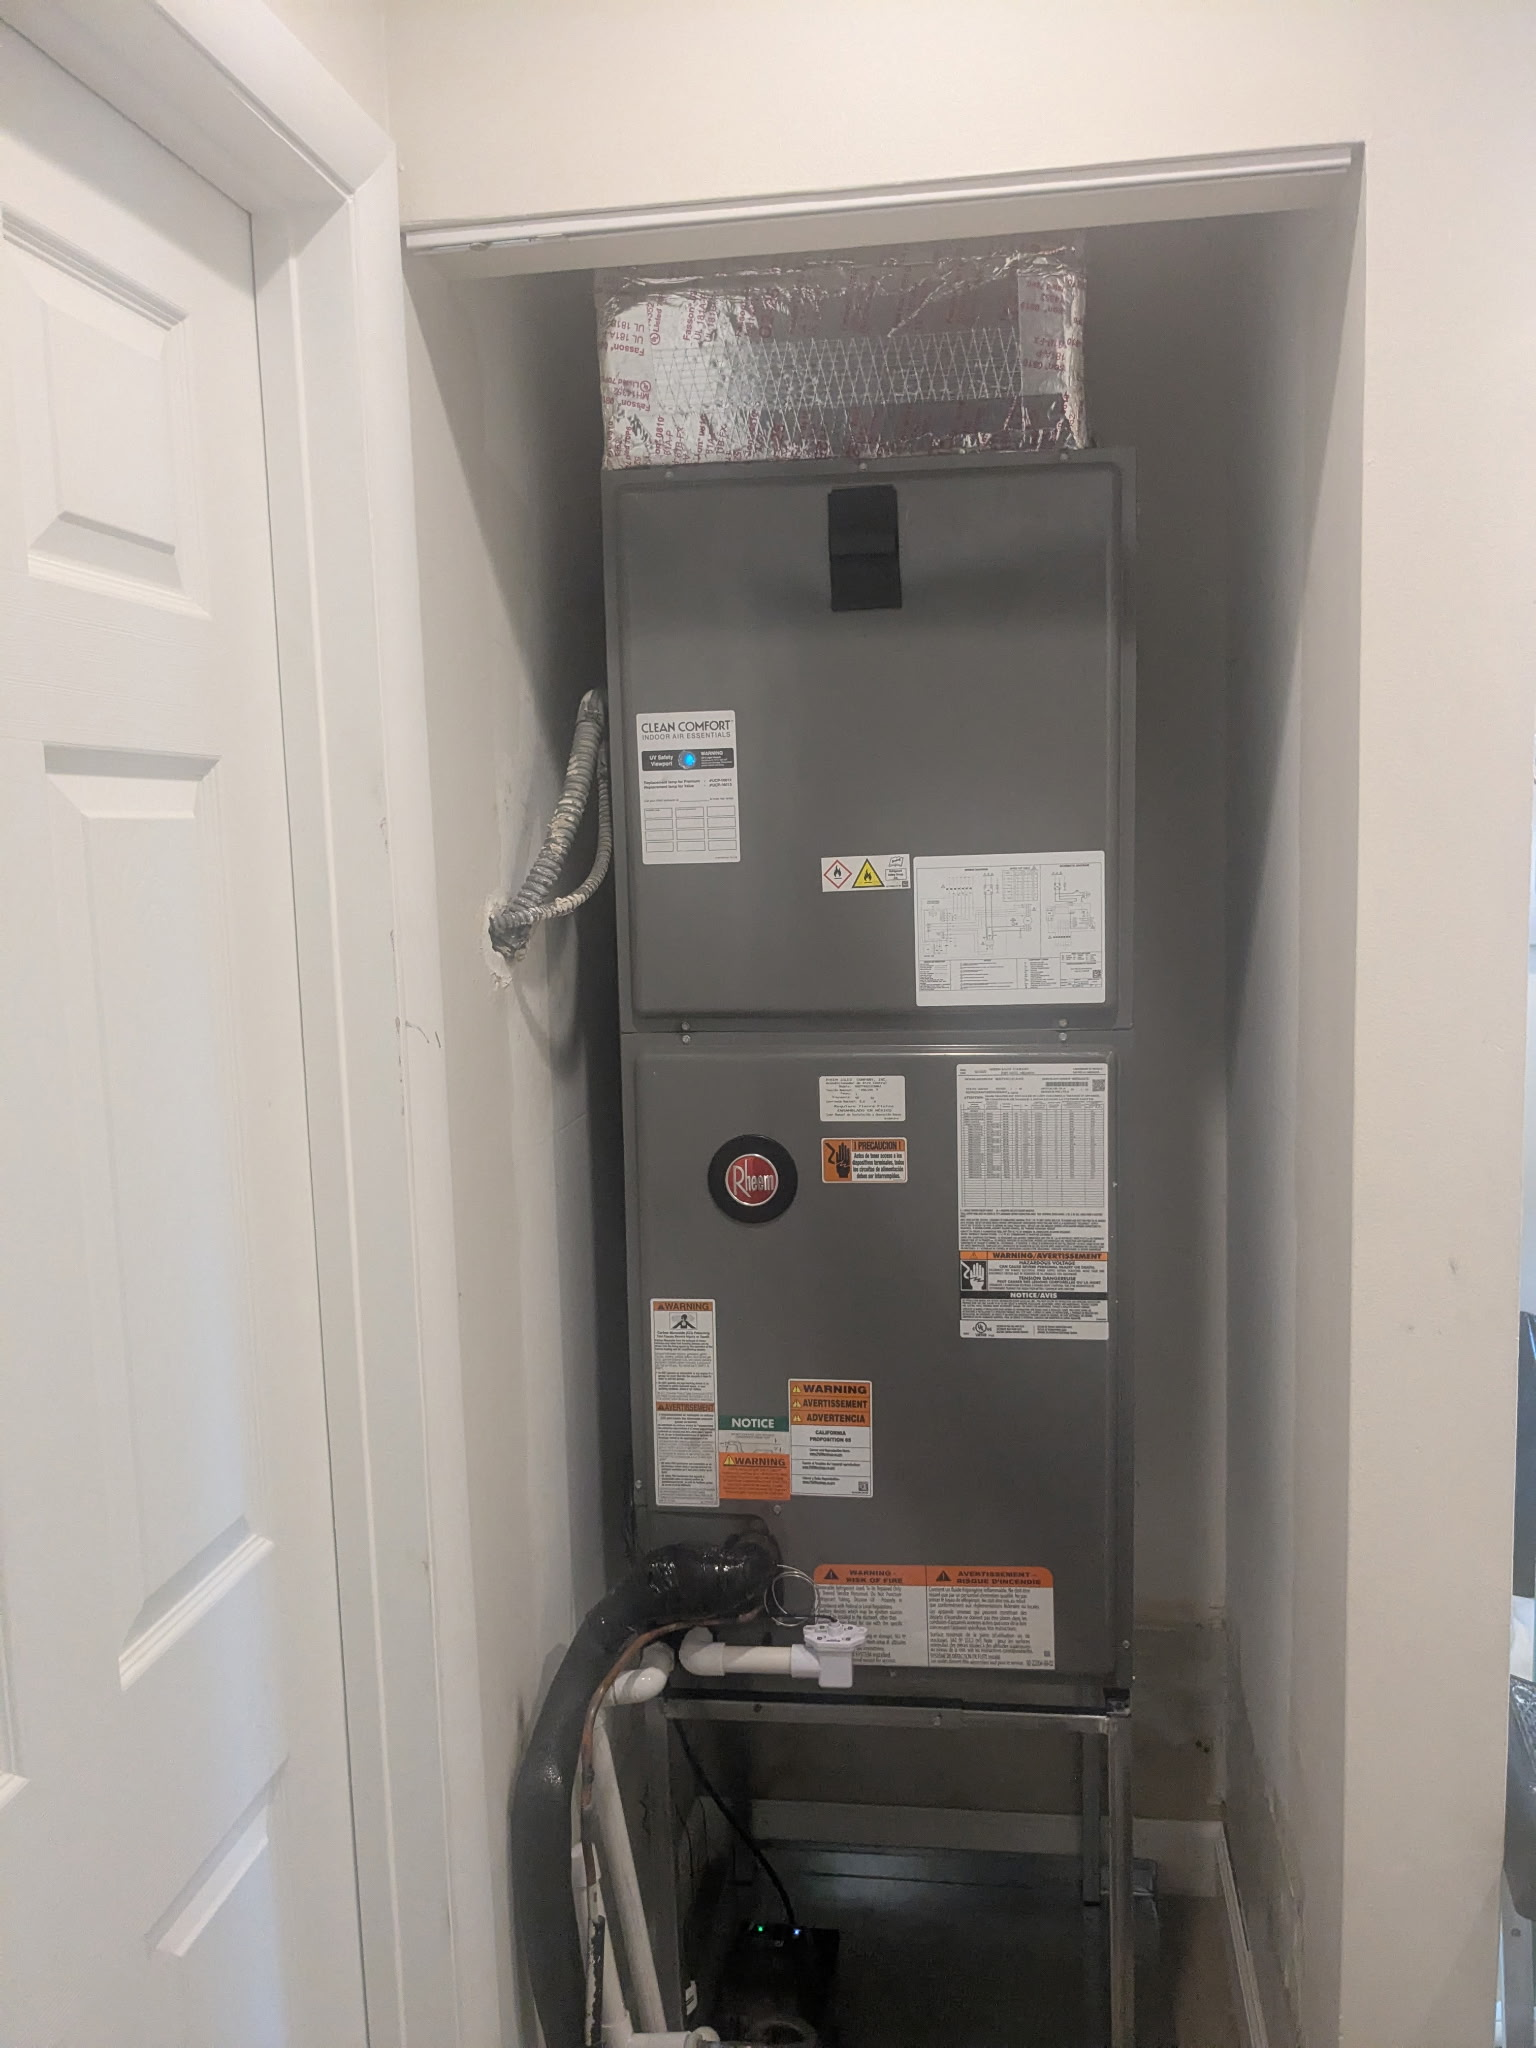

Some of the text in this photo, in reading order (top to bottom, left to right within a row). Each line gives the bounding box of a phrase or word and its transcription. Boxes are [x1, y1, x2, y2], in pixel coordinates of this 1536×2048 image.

[642, 720, 731, 733] CLEAN COMFORT
[732, 1159, 774, 1198] Rheem
[803, 1384, 867, 1394] WARNING
[803, 1399, 867, 1408] AVERTISSEMENT
[732, 1418, 774, 1428] NOTICE
[807, 1414, 866, 1423] ADVERTENCIA
[735, 1458, 785, 1466] WARNING
